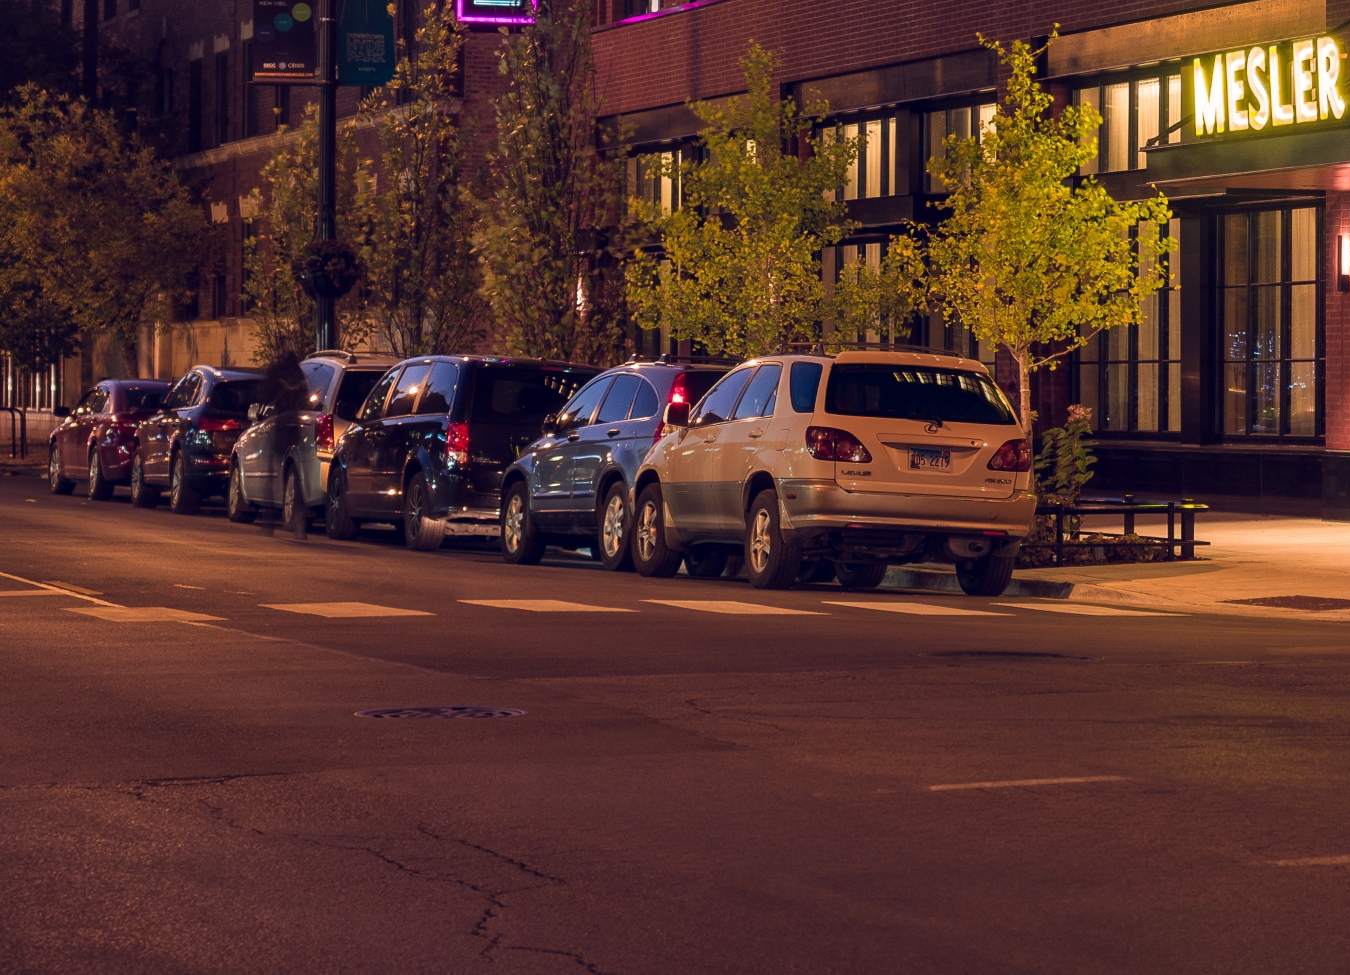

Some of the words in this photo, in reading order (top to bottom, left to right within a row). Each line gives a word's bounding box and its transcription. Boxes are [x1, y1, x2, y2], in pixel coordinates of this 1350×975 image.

[346, 32, 385, 40] DOWNTOWN
[346, 38, 386, 52] HYDE
[346, 50, 387, 63] PARK
[1193, 36, 1347, 137] MESLER
[929, 455, 950, 468] 2279
